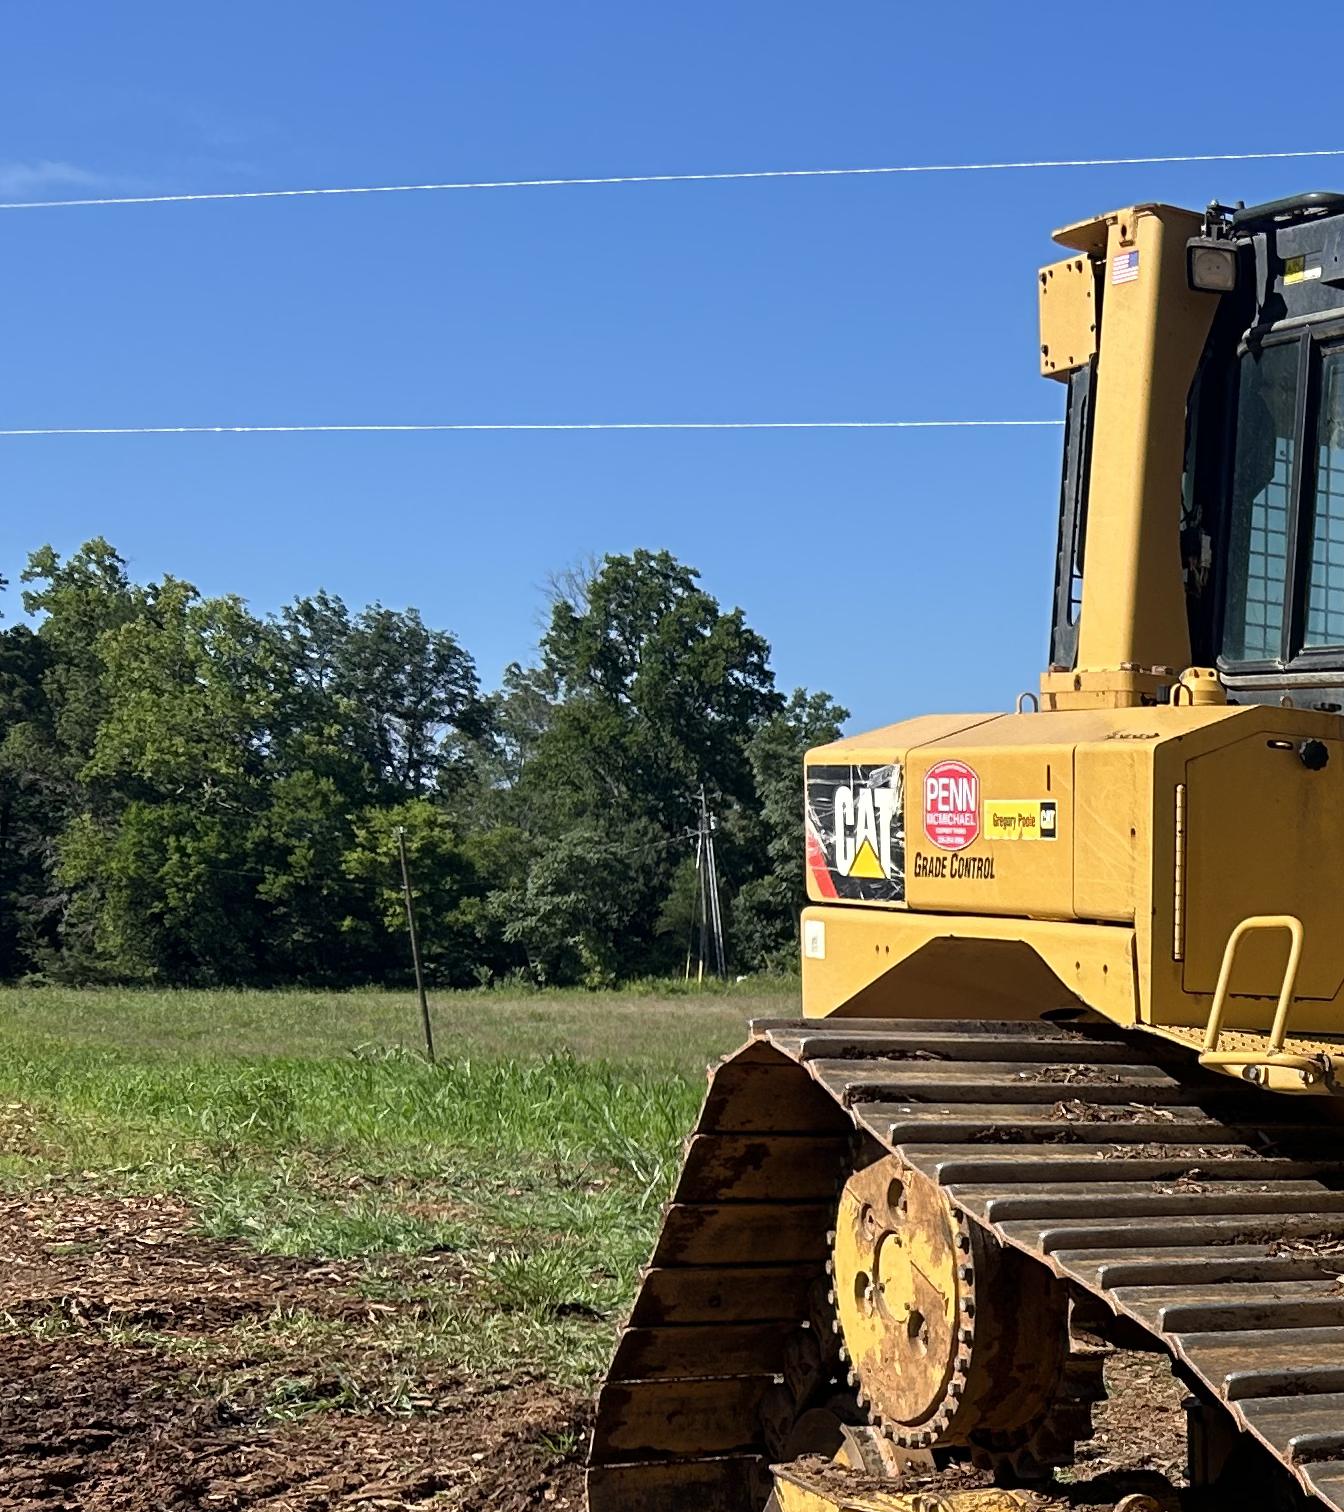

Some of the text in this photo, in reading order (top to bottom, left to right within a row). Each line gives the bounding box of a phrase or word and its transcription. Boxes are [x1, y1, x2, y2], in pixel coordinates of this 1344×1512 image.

[926, 777, 976, 812] PENN
[834, 785, 899, 880] CAT
[993, 812, 1017, 831] Gregory
[1040, 809, 1056, 830] CAT
[914, 851, 996, 880] GRADE CONTROL
